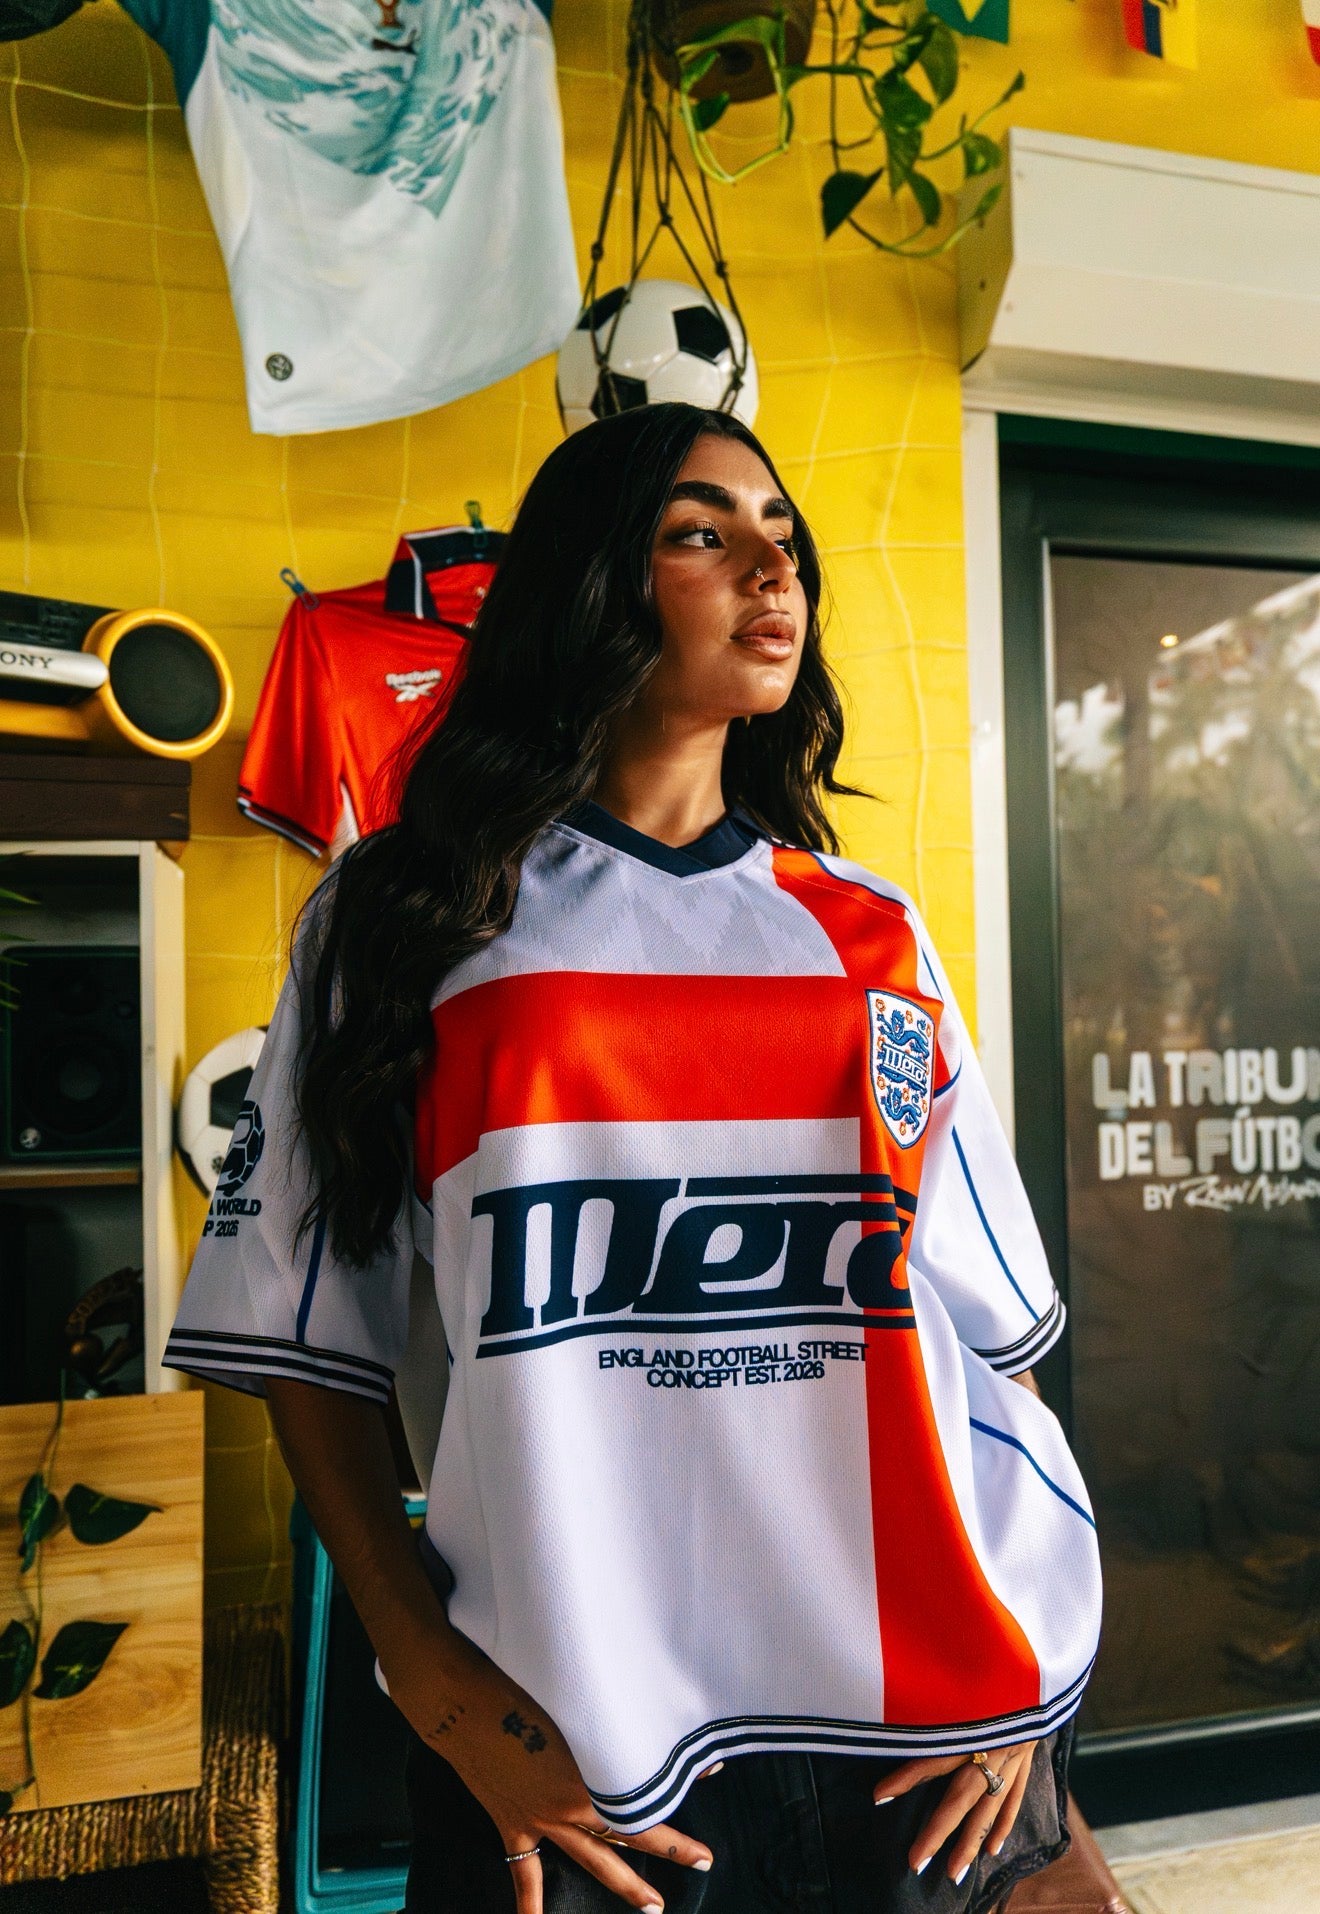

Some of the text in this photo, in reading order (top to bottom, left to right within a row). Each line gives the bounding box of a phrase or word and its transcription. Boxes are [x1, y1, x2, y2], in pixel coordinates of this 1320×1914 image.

[0, 651, 52, 668] ONY
[1093, 1051, 1156, 1110] LA
[1098, 1121, 1193, 1180] DEL
[1143, 1183, 1177, 1211] BY
[599, 1341, 869, 1370] ENGLAND FOOTBALL STREET
[647, 1361, 826, 1389] CONCEPT EST. 2026
